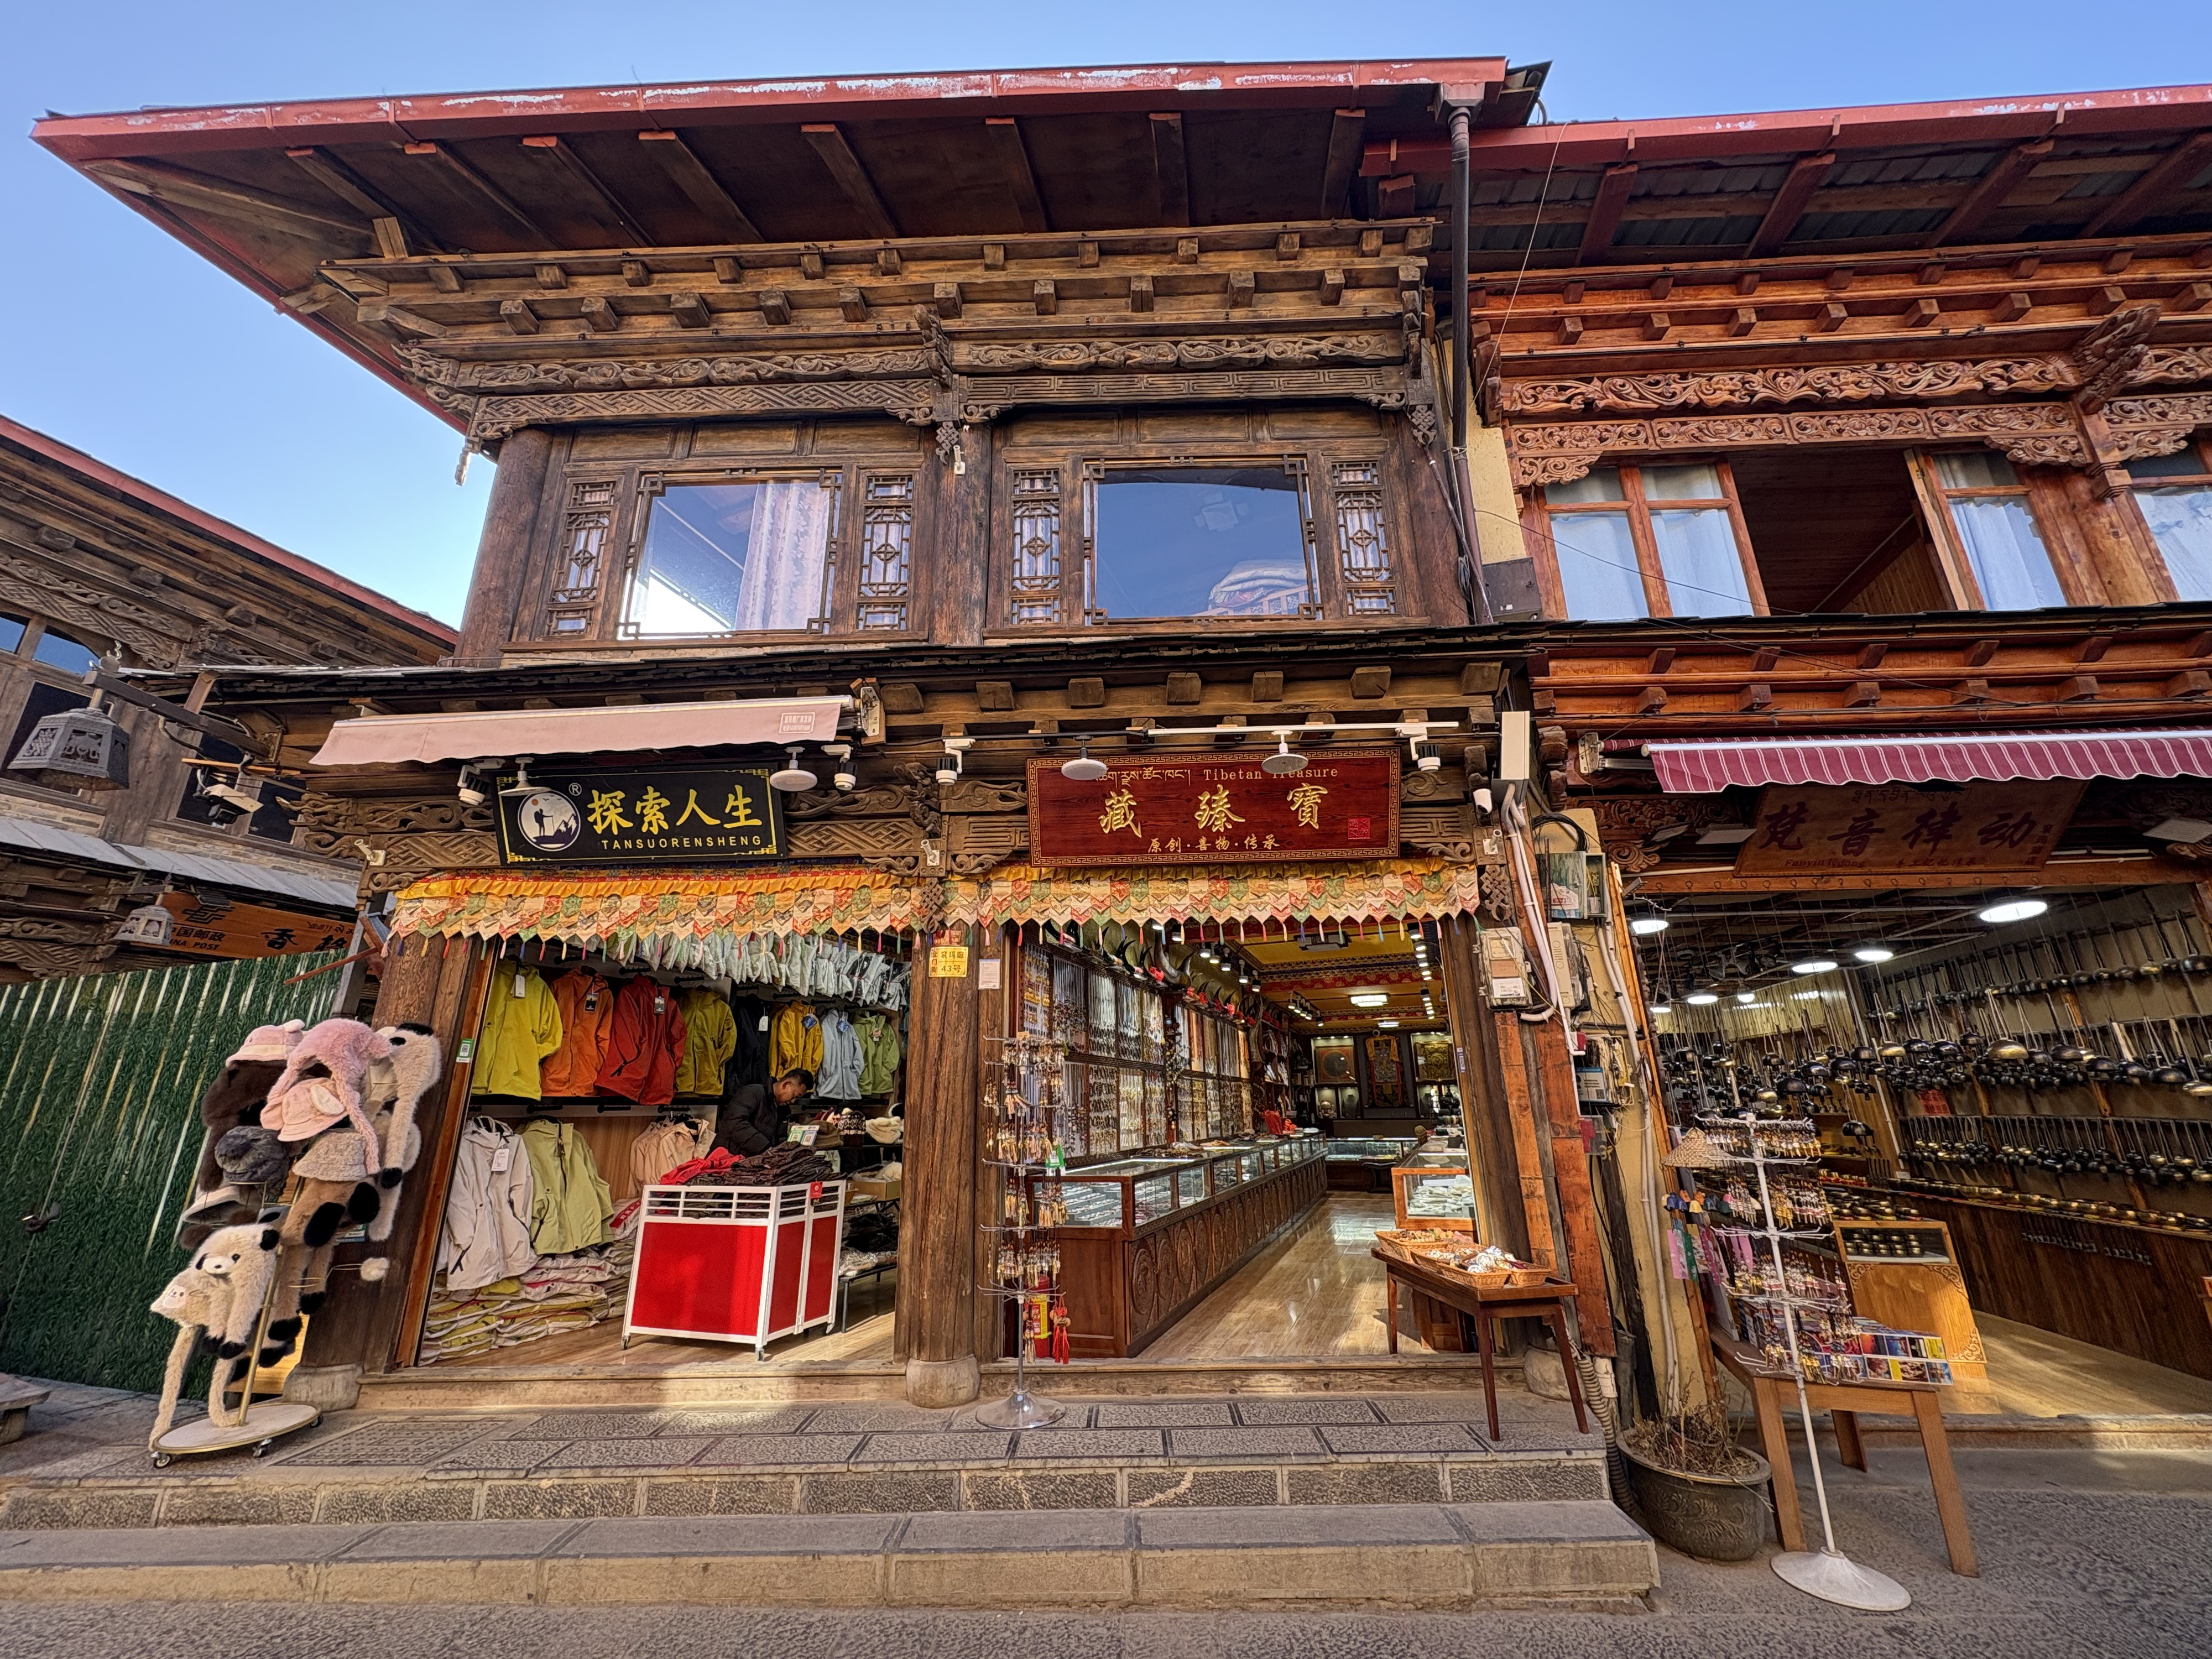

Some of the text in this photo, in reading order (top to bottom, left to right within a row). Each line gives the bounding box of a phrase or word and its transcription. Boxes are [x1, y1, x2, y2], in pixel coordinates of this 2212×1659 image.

[1203, 768, 1262, 781] Tibetan
[587, 784, 763, 836] 探索人生
[1759, 801, 2037, 857] 梵音律动
[601, 836, 761, 851] TANSUORENSHENG
[1784, 859, 1824, 868] Fanyin
[193, 942, 220, 951] POST
[941, 964, 962, 973] 43号
